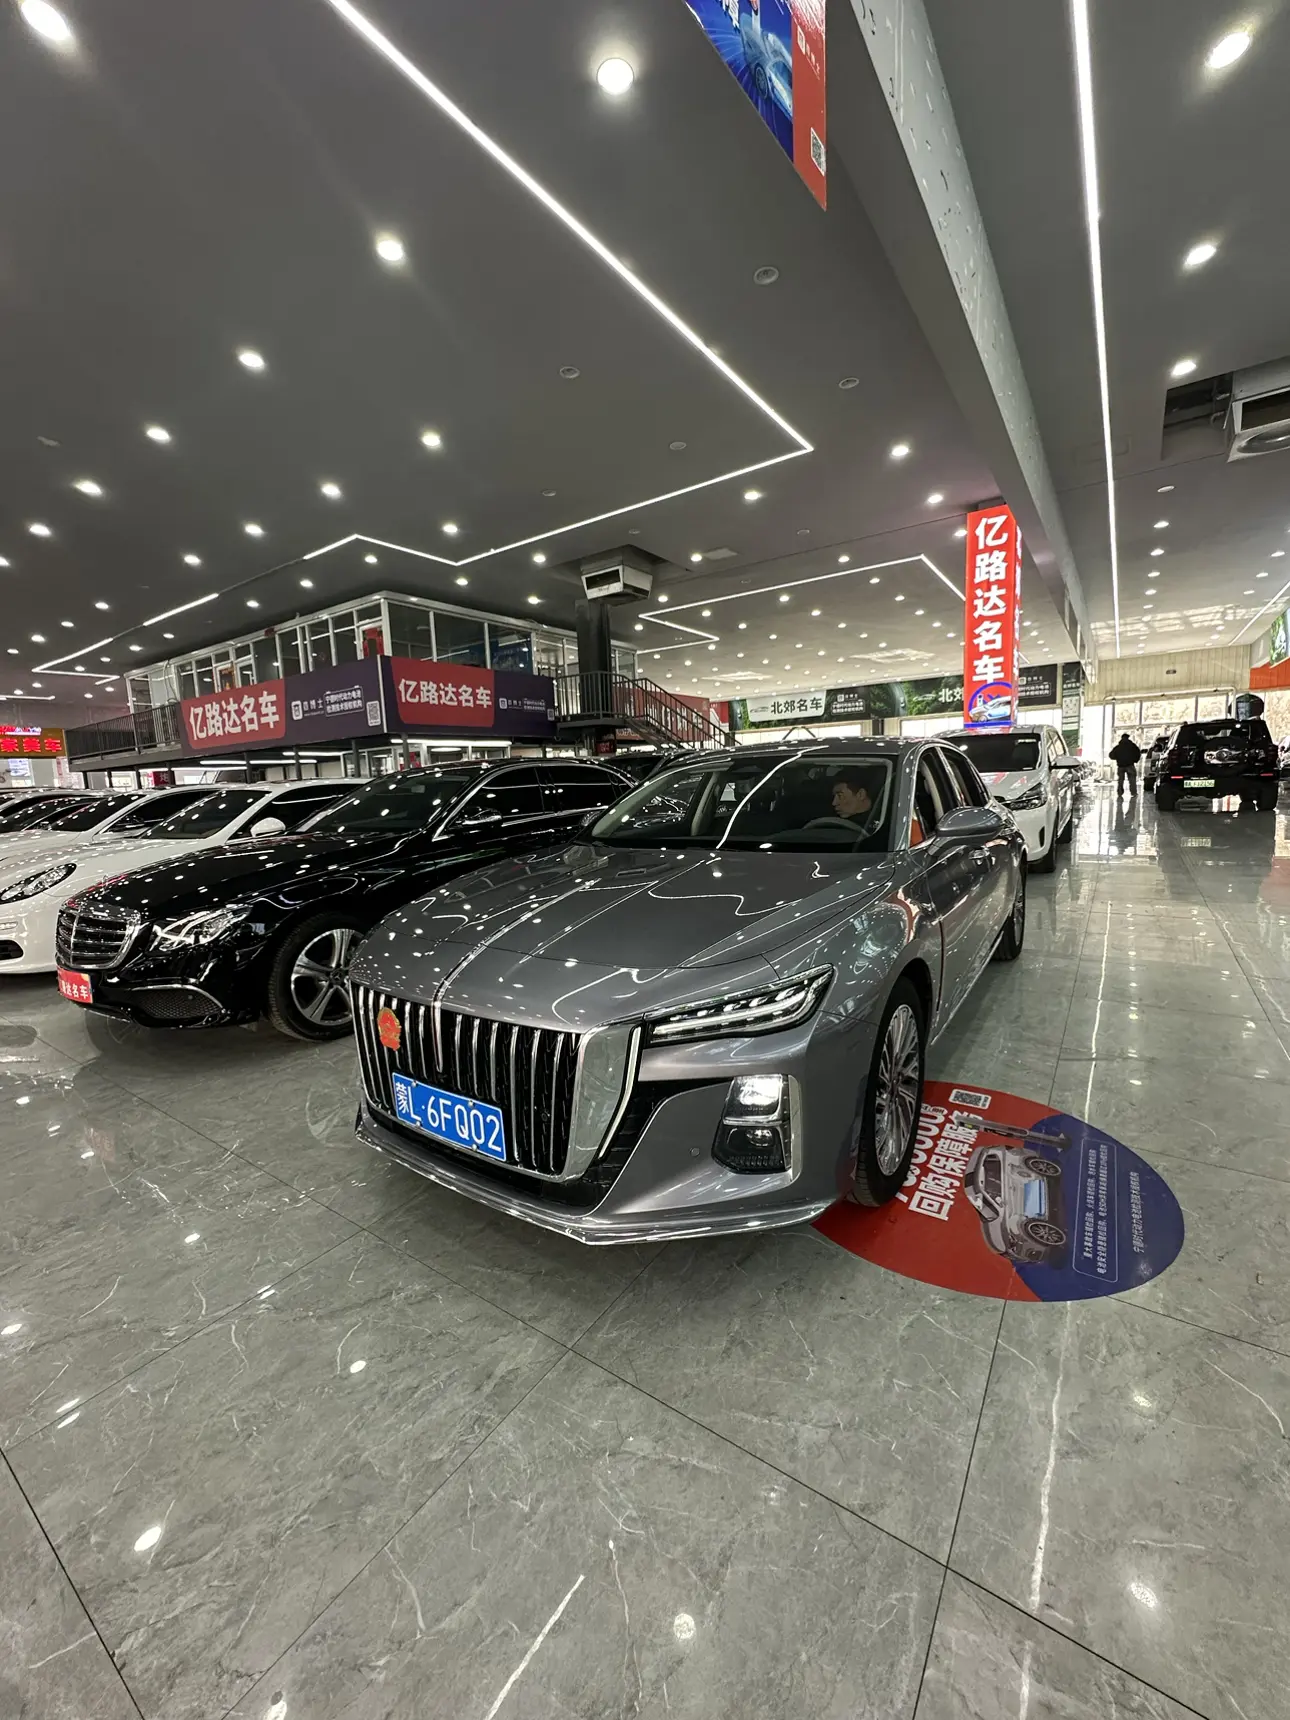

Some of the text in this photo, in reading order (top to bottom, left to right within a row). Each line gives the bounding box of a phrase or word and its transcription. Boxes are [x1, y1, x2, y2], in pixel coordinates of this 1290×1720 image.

[972, 515, 1008, 685] 亿路达名车
[189, 690, 280, 740] 亿路达名车
[398, 678, 492, 709] 亿路达名车
[770, 697, 823, 715] 北郊名车
[396, 1081, 502, 1153] 蒙L·6FQ02
